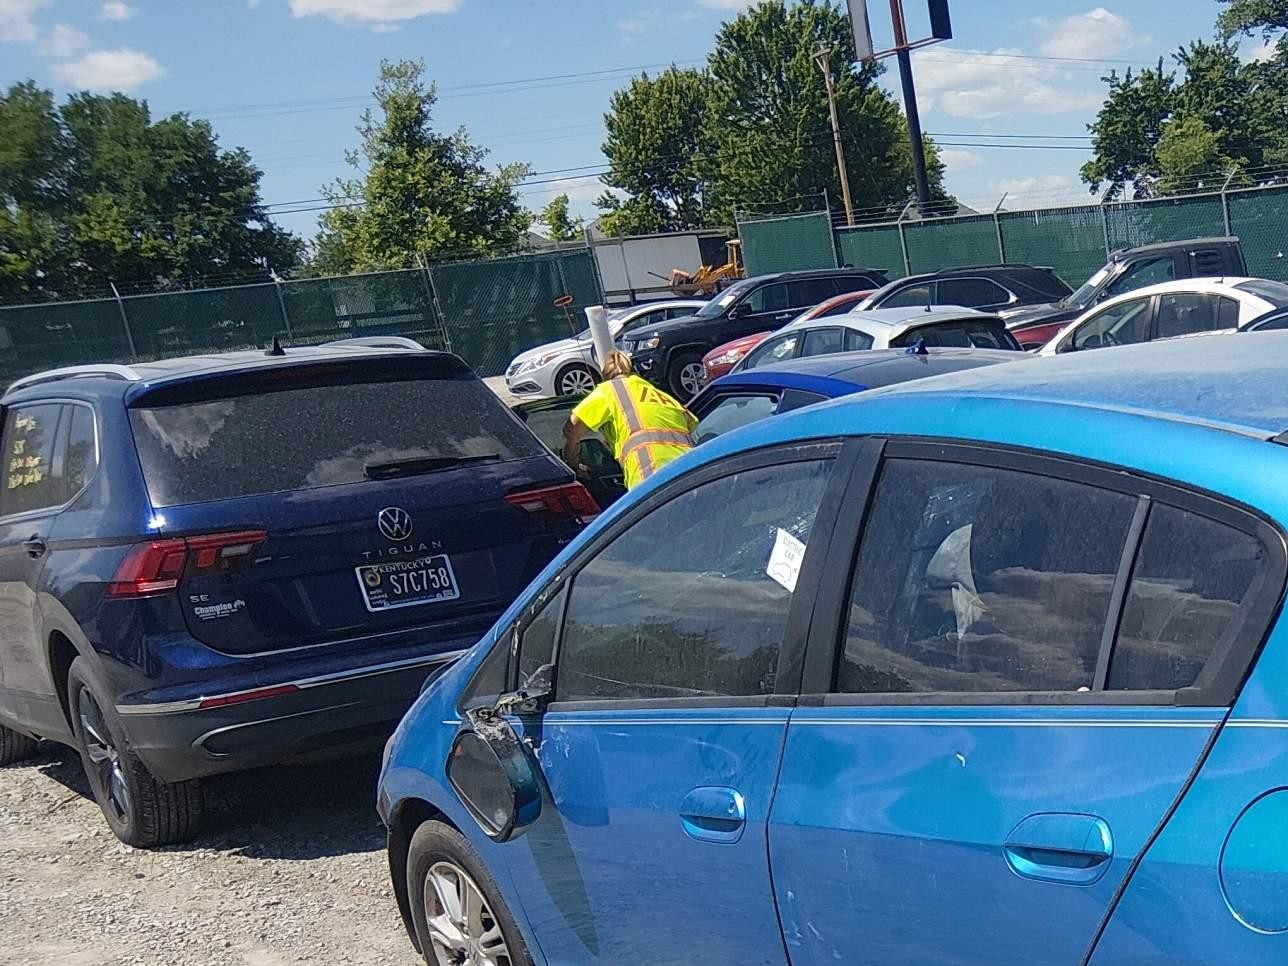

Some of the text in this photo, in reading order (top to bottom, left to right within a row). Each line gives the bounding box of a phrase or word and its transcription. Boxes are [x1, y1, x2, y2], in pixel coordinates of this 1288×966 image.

[362, 540, 442, 559] TIGUAN
[380, 560, 424, 575] KENTUCKY
[389, 567, 451, 595] S7C758
[190, 595, 210, 603] SE
[194, 603, 233, 615] Champion
